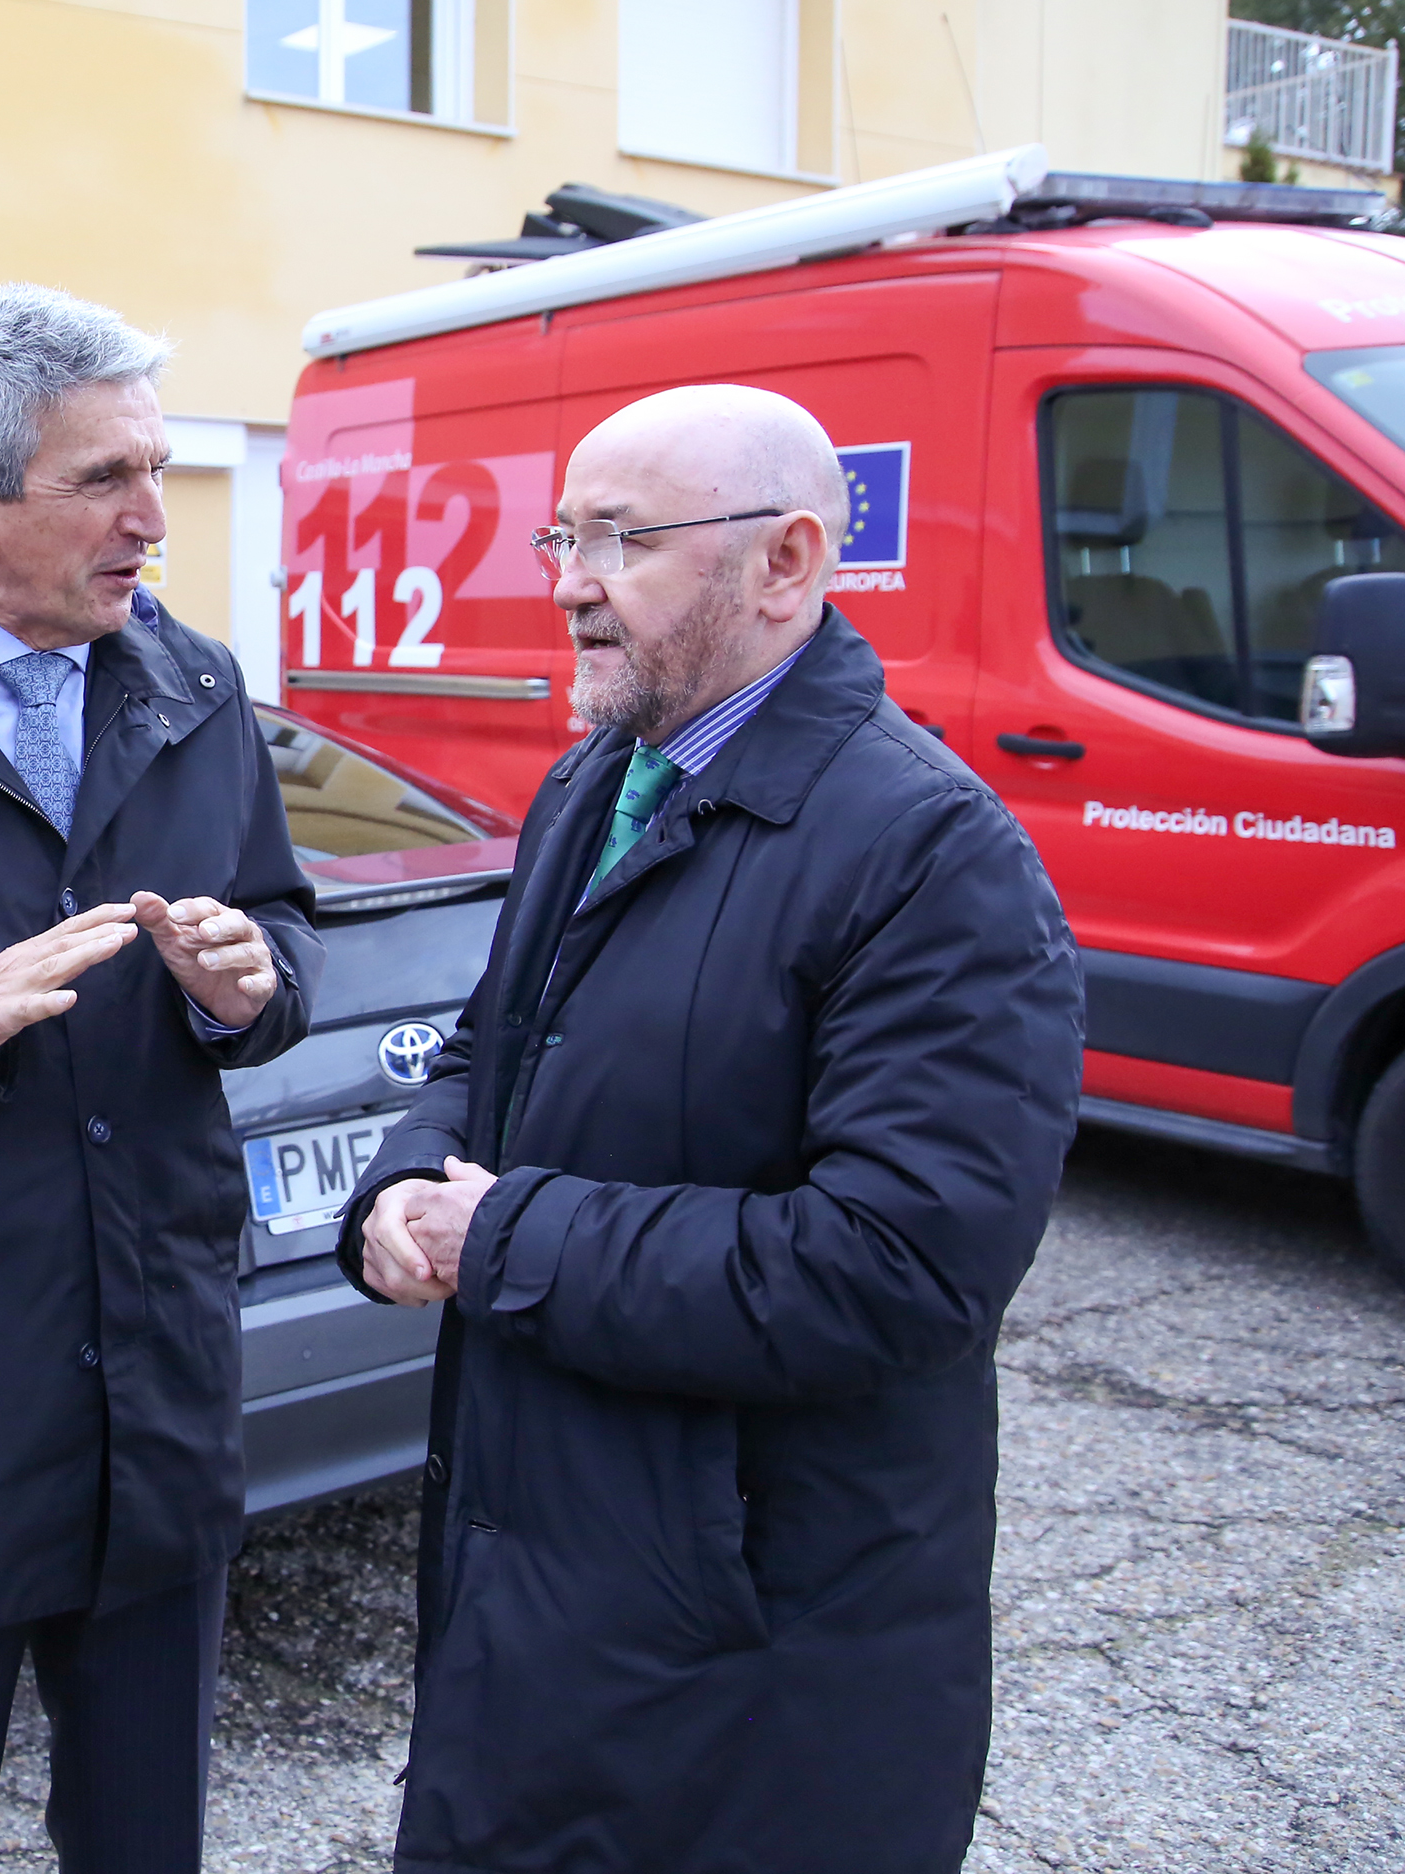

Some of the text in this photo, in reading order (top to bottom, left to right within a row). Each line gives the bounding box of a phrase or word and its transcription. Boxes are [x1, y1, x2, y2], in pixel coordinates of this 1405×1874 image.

[296, 461, 501, 600] 112
[289, 566, 445, 667] 112
[1083, 801, 1396, 848] Protección Ciudadana
[260, 1185, 273, 1203] E
